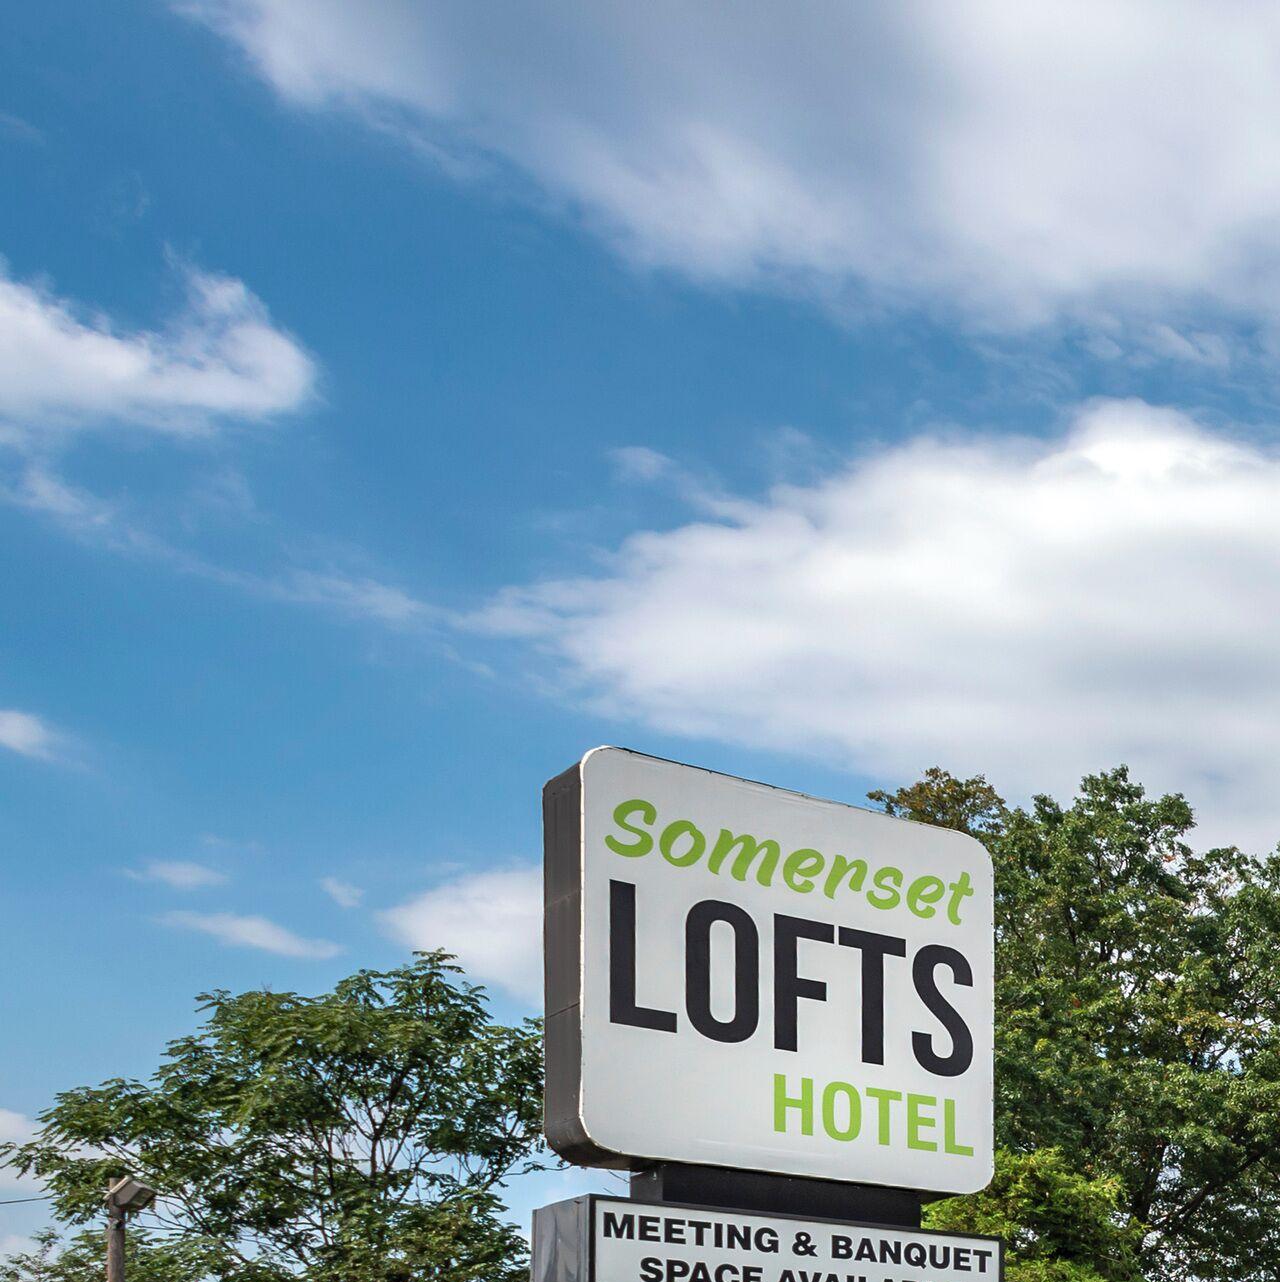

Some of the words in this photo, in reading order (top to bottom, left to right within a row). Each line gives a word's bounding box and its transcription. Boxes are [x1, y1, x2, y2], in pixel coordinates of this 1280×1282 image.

[604, 799, 974, 926] Somerset
[608, 879, 974, 1077] LOFTS
[773, 1073, 974, 1157] HOTEL
[602, 1212, 779, 1254] MEETING
[791, 1231, 818, 1258] &
[831, 1234, 993, 1274] BANQUET
